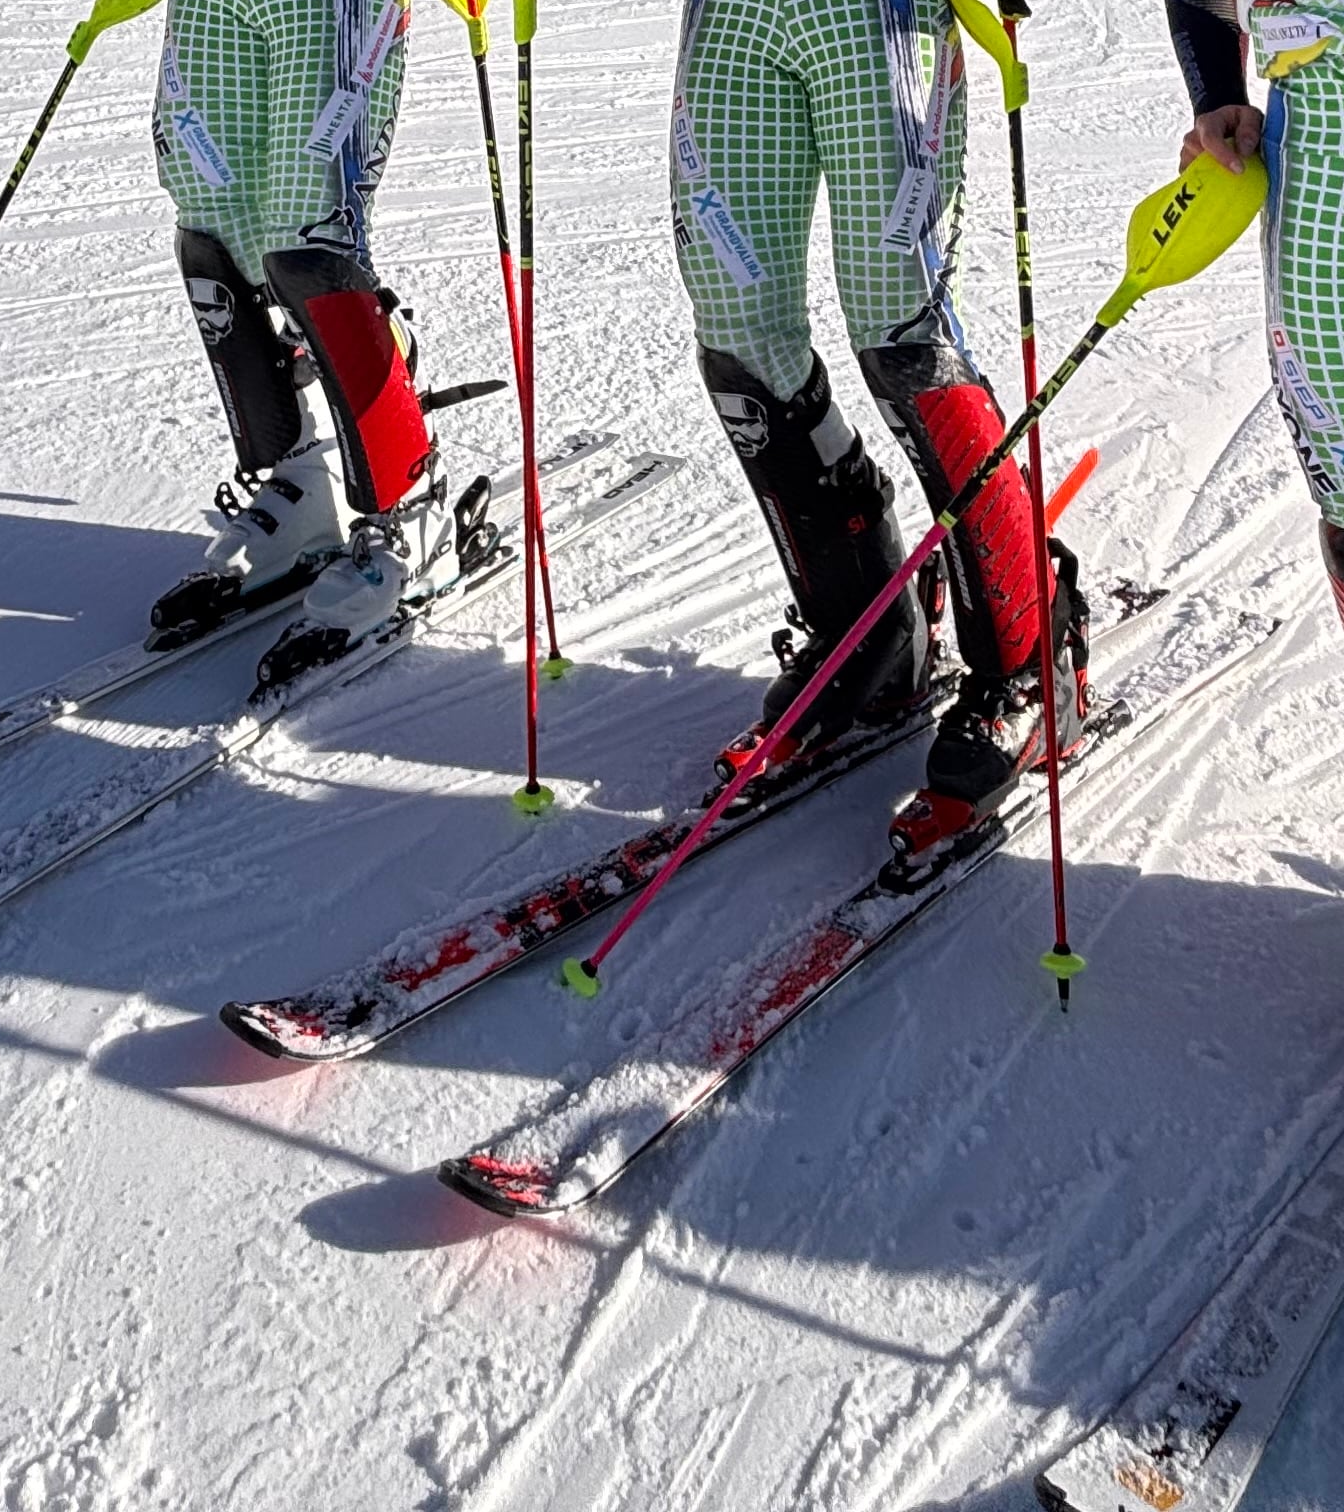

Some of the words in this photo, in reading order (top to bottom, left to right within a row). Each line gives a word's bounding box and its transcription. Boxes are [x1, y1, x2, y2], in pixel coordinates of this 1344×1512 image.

[163, 48, 179, 93] SIEP
[365, 37, 384, 69] andorra
[328, 96, 356, 139] MENTA
[933, 91, 945, 136] andorra
[192, 126, 233, 183] GRANDVALIRA
[675, 118, 698, 171] SIEP
[902, 176, 926, 228] MENTA
[1153, 181, 1201, 247] LEK
[715, 210, 762, 280] GRANDVALIRA
[1015, 207, 1032, 287] LEKI
[1282, 360, 1326, 421] SIEP
[277, 439, 322, 462] HEA
[401, 539, 453, 585] HEAD
